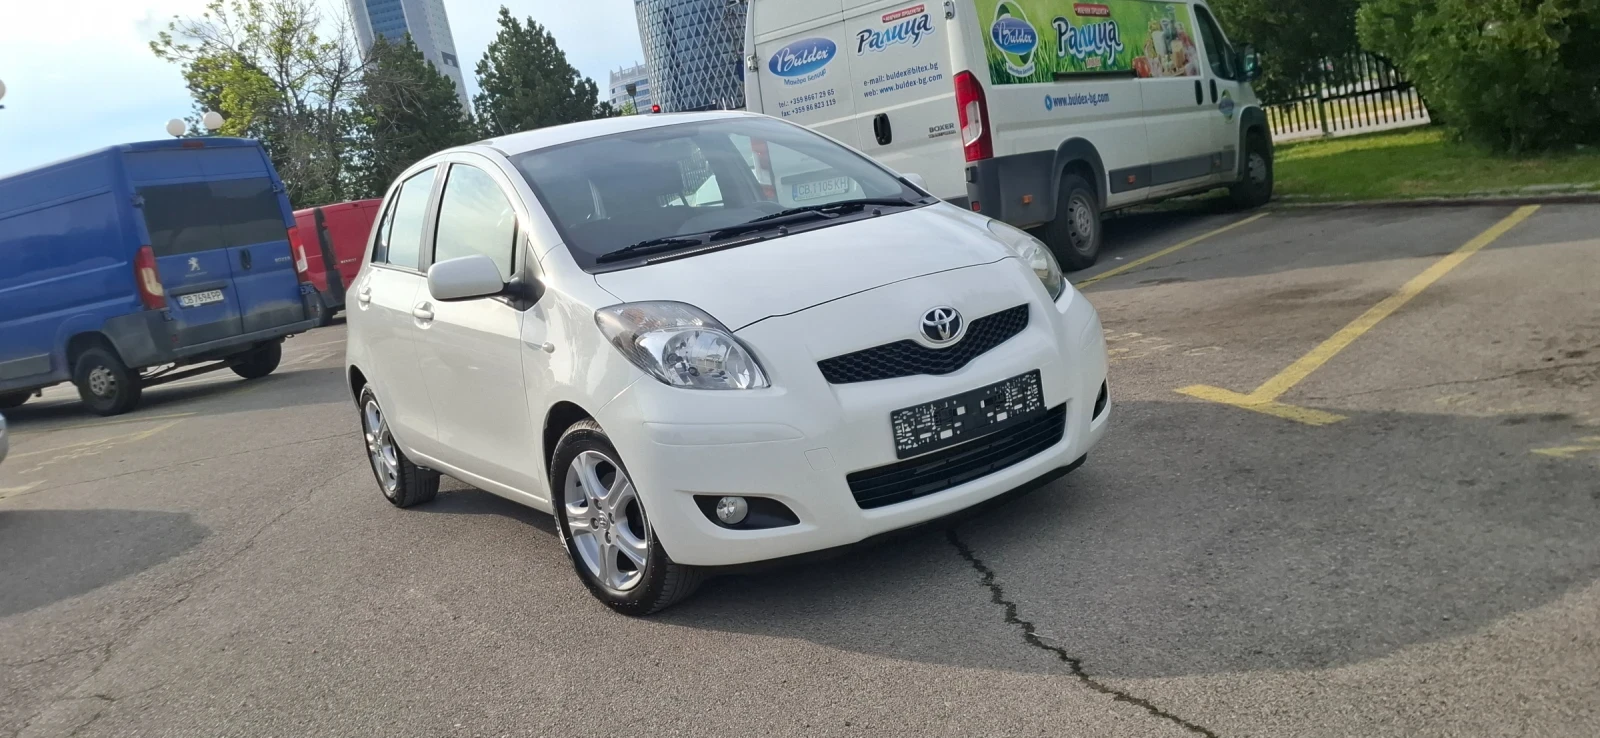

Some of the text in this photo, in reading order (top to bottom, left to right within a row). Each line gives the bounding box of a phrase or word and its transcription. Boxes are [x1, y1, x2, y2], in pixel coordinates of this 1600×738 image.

[856, 14, 932, 53] Ралица
[995, 21, 1033, 46] Buldex
[1052, 16, 1122, 61] Ралица
[776, 46, 829, 73] Buldex
[863, 62, 939, 87] e-mail: buldex@bitex.bg
[863, 73, 943, 98] web: www.buldex-bg.com
[790, 97, 804, 105] +359
[791, 105, 806, 114] +359
[1052, 92, 1110, 107] www.buldex-bg.com
[928, 122, 955, 133] BOXER
